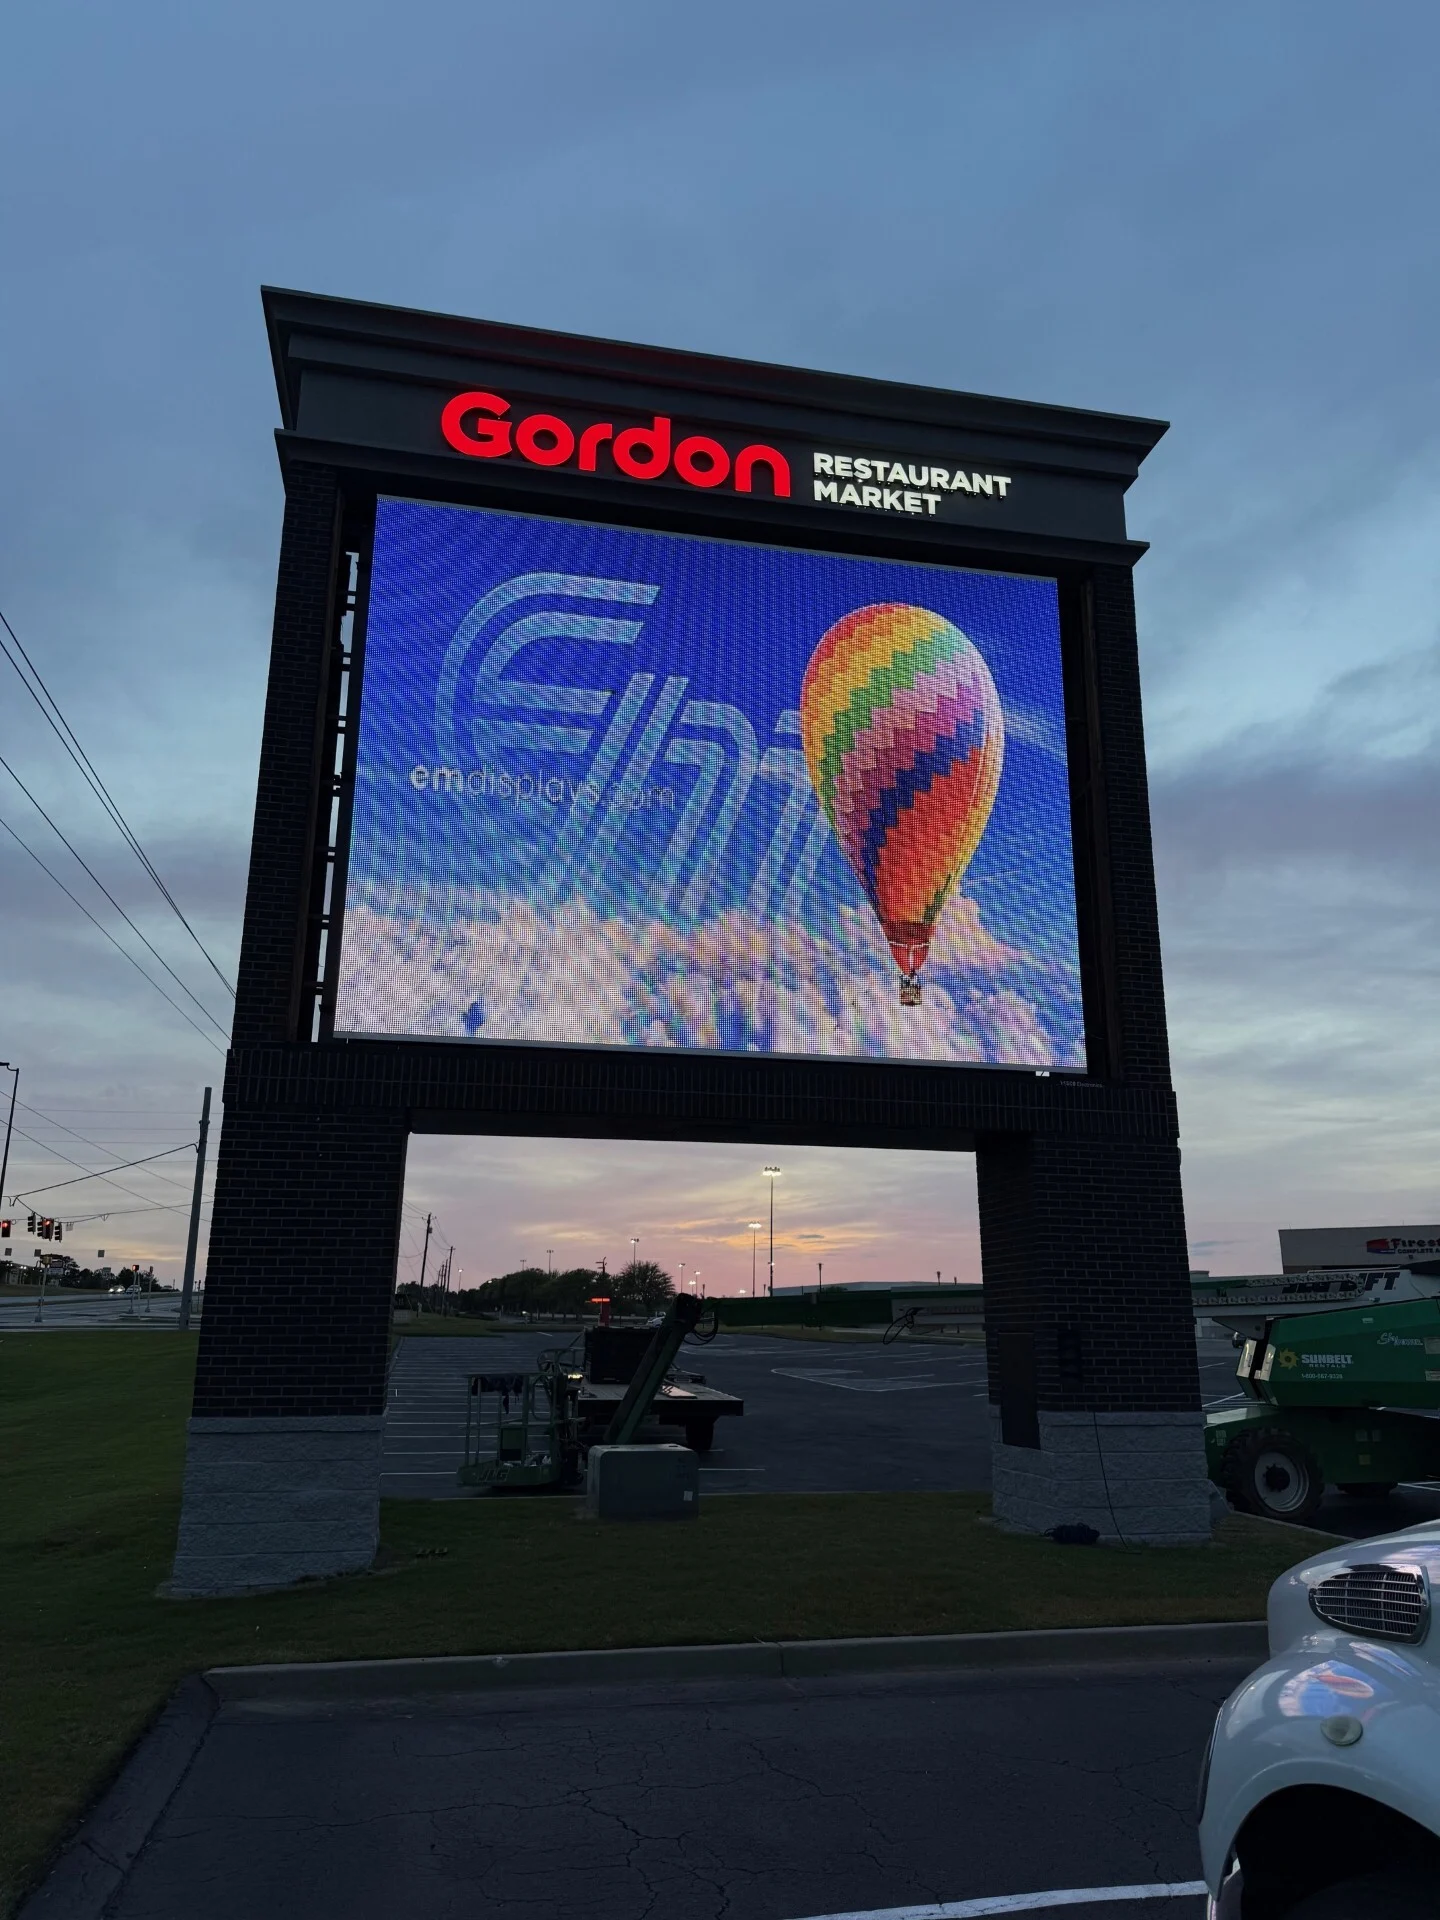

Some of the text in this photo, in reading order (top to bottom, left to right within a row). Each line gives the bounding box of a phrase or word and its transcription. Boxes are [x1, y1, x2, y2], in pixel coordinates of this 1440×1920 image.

[441, 391, 792, 498] Gordon
[813, 451, 1012, 500] RESTAURANT
[813, 480, 942, 516] MARKET
[409, 763, 674, 811] emdisplays.com
[1301, 1354, 1353, 1364] SUNBELT
